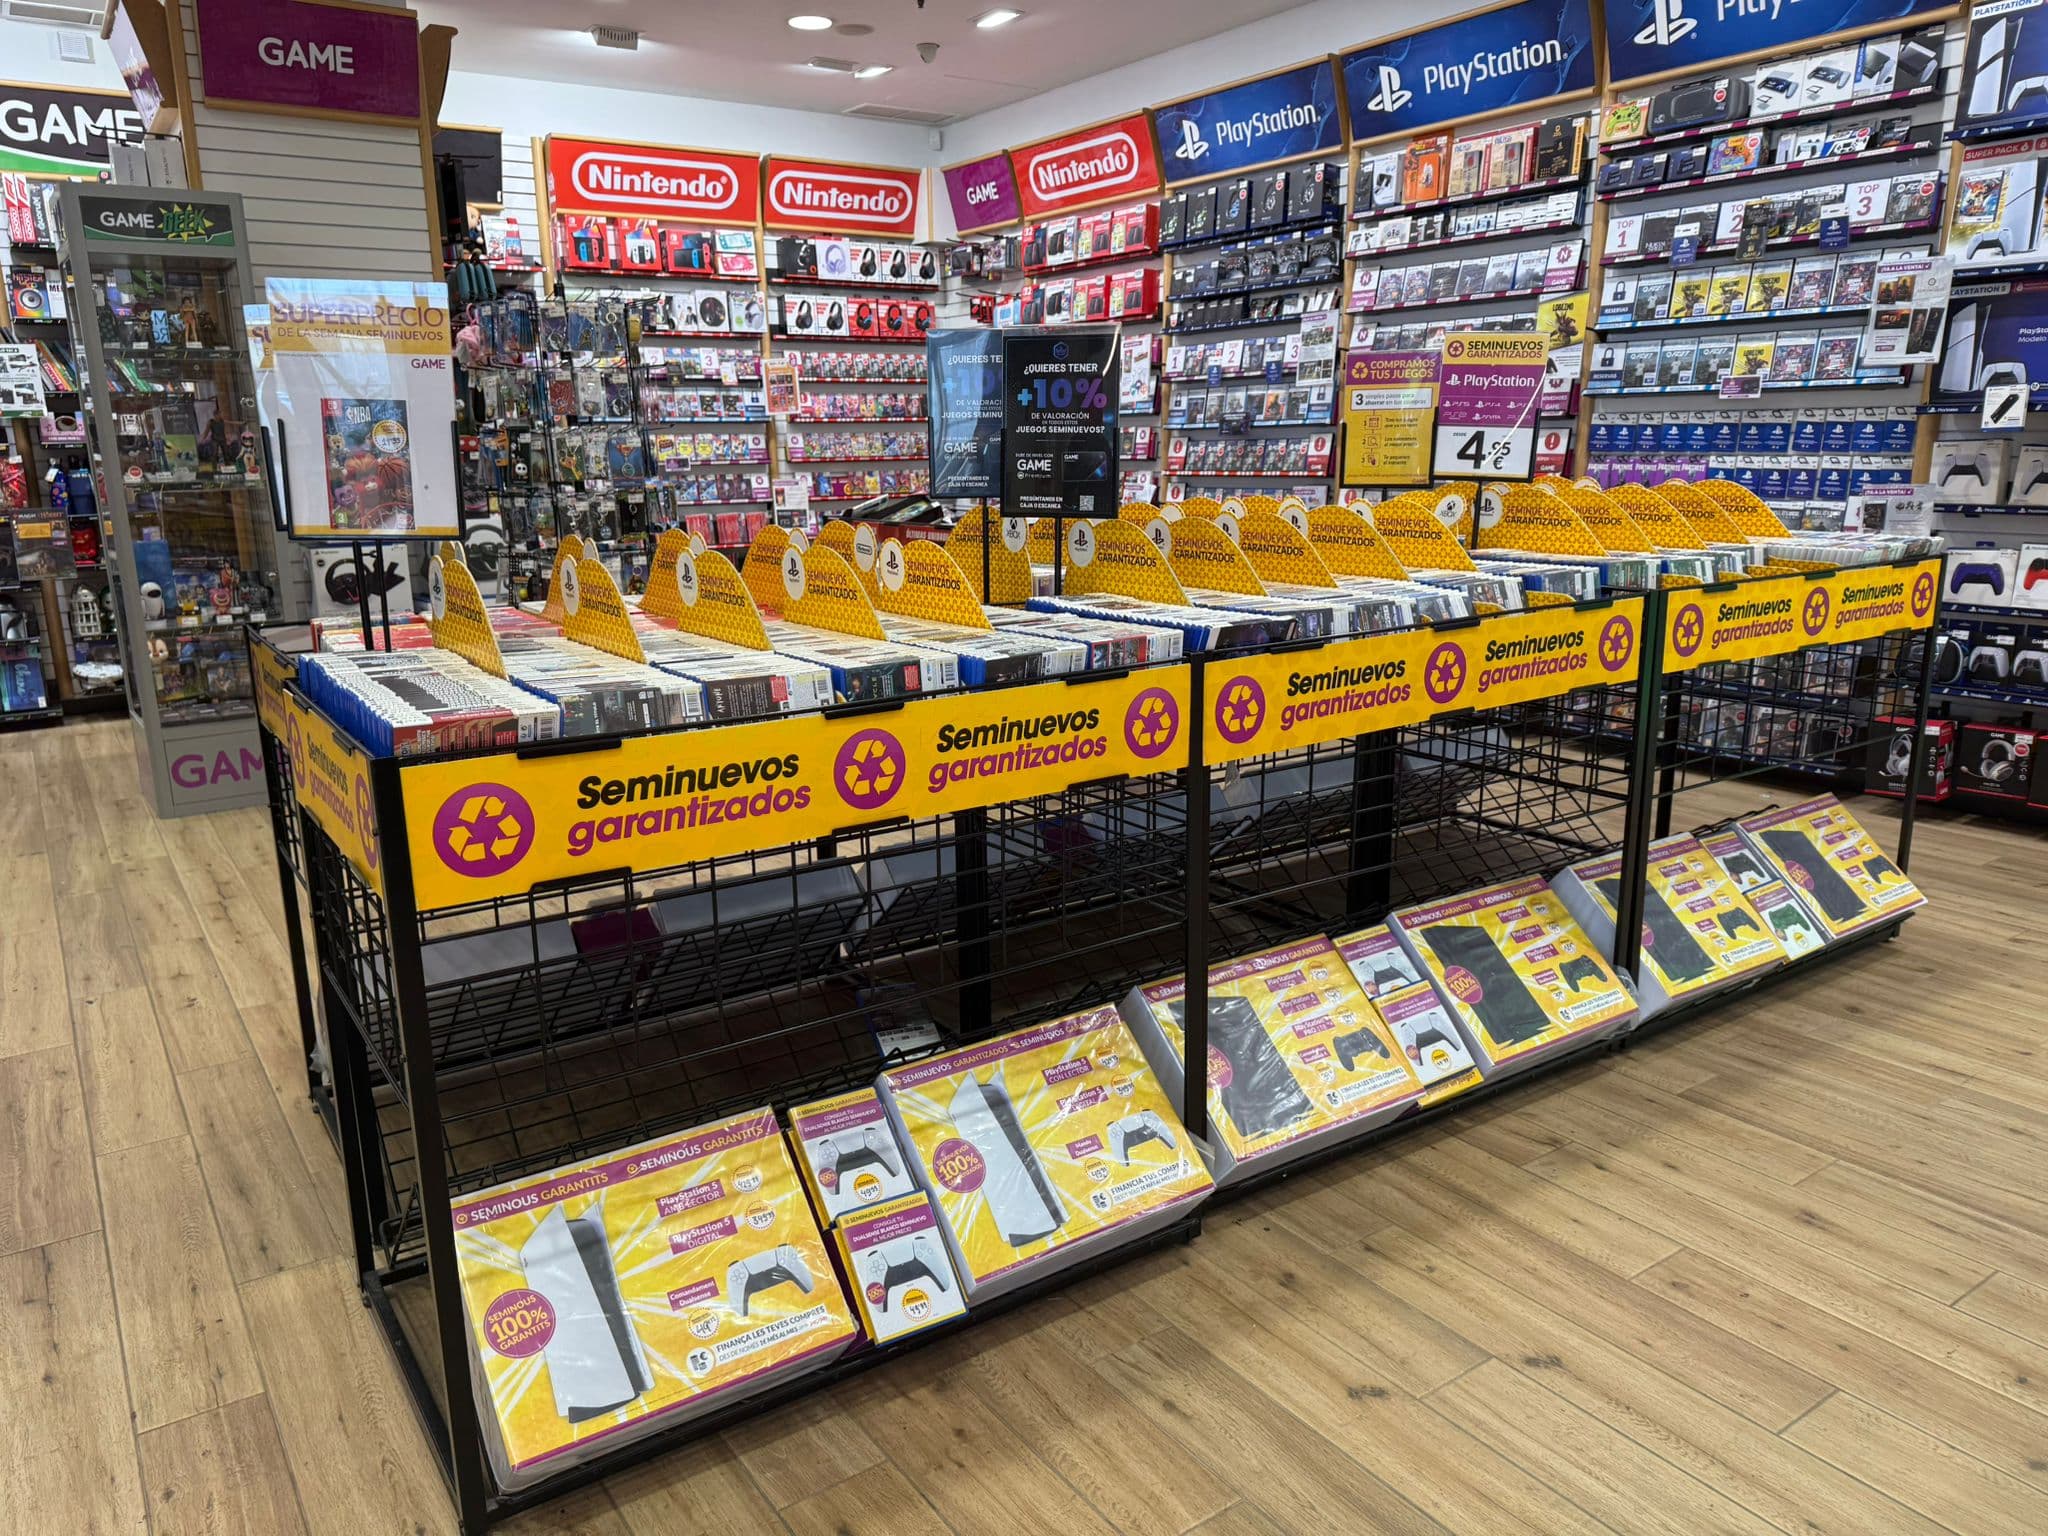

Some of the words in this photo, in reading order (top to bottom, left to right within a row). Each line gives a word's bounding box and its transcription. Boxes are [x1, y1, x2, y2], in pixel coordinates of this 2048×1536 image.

[258, 37, 354, 75] GAME
[1424, 39, 1565, 95] PlayStation
[1216, 104, 1317, 147] PlayStation
[1965, 149, 1996, 161] SUPER
[1998, 145, 2020, 156] PACK
[1038, 148, 1128, 192] Nintendo
[588, 163, 724, 200] Nintendo
[1857, 184, 1880, 194] TOP
[783, 181, 901, 213] Nintendo
[967, 181, 999, 206] GAME
[1857, 196, 1872, 217] 3
[100, 211, 155, 230] GAME
[162, 206, 206, 234] GEEK
[1617, 220, 1634, 229] TOP
[1729, 216, 1744, 233] 2
[1617, 231, 1627, 248] 1
[1951, 286, 1998, 296] LAYSTATION
[274, 303, 443, 326] SUPERPRECIO
[278, 327, 293, 337] DE
[366, 329, 443, 341] SEMINUEVOS
[1466, 350, 1542, 359] GARANTIZADOS
[1467, 340, 1544, 351] SEMINUEVOS
[411, 358, 446, 369] GAME
[947, 354, 988, 366] ¿QUIERES
[1024, 363, 1066, 375] ¿QUIERES
[1069, 363, 1098, 373] TENER
[1371, 358, 1436, 369] COMPRAMOS
[1370, 370, 1389, 379] TUS
[1392, 368, 1434, 379] JUEGOS
[1464, 374, 1535, 390] PlayStation
[1017, 378, 1107, 409] +10%
[1355, 393, 1364, 406] 3
[941, 411, 970, 419] JUEGOS
[1042, 411, 1090, 420] VALORACIÓN
[1048, 425, 1105, 434] SEMINUEVOS?
[944, 442, 977, 453] GAME
[1017, 459, 1051, 471] GAME
[1493, 456, 1504, 470] €
[1506, 505, 1560, 517] SEMINUEVOS
[1311, 523, 1363, 536] SEMINUEVOS
[1377, 517, 1430, 530] SEMINUEVOS
[1504, 516, 1572, 528] GARANTIZADOS
[1174, 538, 1224, 550] SEMINUEVOS
[1241, 531, 1293, 544] SEMINUEVOS
[1311, 534, 1375, 547] GARANTIZADOS
[1376, 528, 1442, 541] GARANTIZADOS
[1099, 541, 1146, 555] SEMINUEVOS
[1174, 550, 1235, 563] GARANTIZADOS
[1241, 542, 1304, 557] GARANTIZADOS
[907, 560, 950, 575] SEMINUEVOS
[1097, 553, 1157, 568] GARANTIZADOS
[807, 569, 847, 585] SEMINUEVOS
[907, 574, 961, 590] GARANTIZADOS
[700, 588, 745, 608] GARANTIZADOS
[808, 582, 858, 601] GARANTIZADOS
[1841, 582, 1904, 604] Seminuevos
[581, 598, 621, 618] GARANTIZADOS
[1717, 598, 1792, 622] Seminuevos
[1835, 601, 1905, 629] garantizados
[1711, 619, 1794, 649] garantizados
[1485, 629, 1585, 662] Seminuevos
[1287, 659, 1406, 697] Seminuevos
[1477, 650, 1588, 693] garantizados
[1280, 681, 1411, 731] garantizados
[936, 707, 1100, 753] Seminuevos
[306, 732, 349, 796] Seminuevos
[928, 734, 1107, 793] garantizados
[577, 752, 799, 811] Seminuevos
[309, 770, 355, 833] garantizados
[566, 782, 811, 857] garantizados
[1484, 890, 1514, 905] SEMINOUS
[1412, 910, 1442, 925] SEMINOUS
[1441, 902, 1473, 917] GARANTITS
[1449, 974, 1476, 996] 100%
[1019, 1028, 1065, 1050] SEMINUEVOS
[902, 1061, 952, 1085] SEMINUEVOS
[953, 1044, 1009, 1068] GARANTIZADOS
[1045, 1062, 1081, 1078] PlayStation
[1049, 1074, 1065, 1083] CON
[1066, 1066, 1090, 1079] LECTOR
[703, 1124, 764, 1151] GARANTITS
[938, 1151, 979, 1186] 100%
[1111, 1179, 1143, 1195] FINANCIA
[1144, 1172, 1157, 1183] TUS
[471, 1193, 539, 1221] SEMINOUS
[540, 1172, 609, 1200] GARANTITS
[660, 1185, 708, 1206] PlayStation
[708, 1181, 718, 1189] 5
[672, 1222, 724, 1243] PlayStation
[724, 1217, 731, 1226] 5
[852, 1230, 880, 1243] DUALSENSE
[880, 1223, 899, 1236] BLANCO
[899, 1214, 927, 1228] SEMINUEVO
[687, 1231, 724, 1249] DIGITAL
[670, 1281, 715, 1300] Comandament
[488, 1293, 537, 1324] SEMINOUS
[489, 1305, 549, 1343] 100%
[716, 1335, 751, 1353] FINANÇA
[751, 1330, 766, 1341] LES
[766, 1320, 789, 1334] TEVES
[789, 1305, 825, 1325] COMPRES
[499, 1319, 551, 1351] GARANTITS
